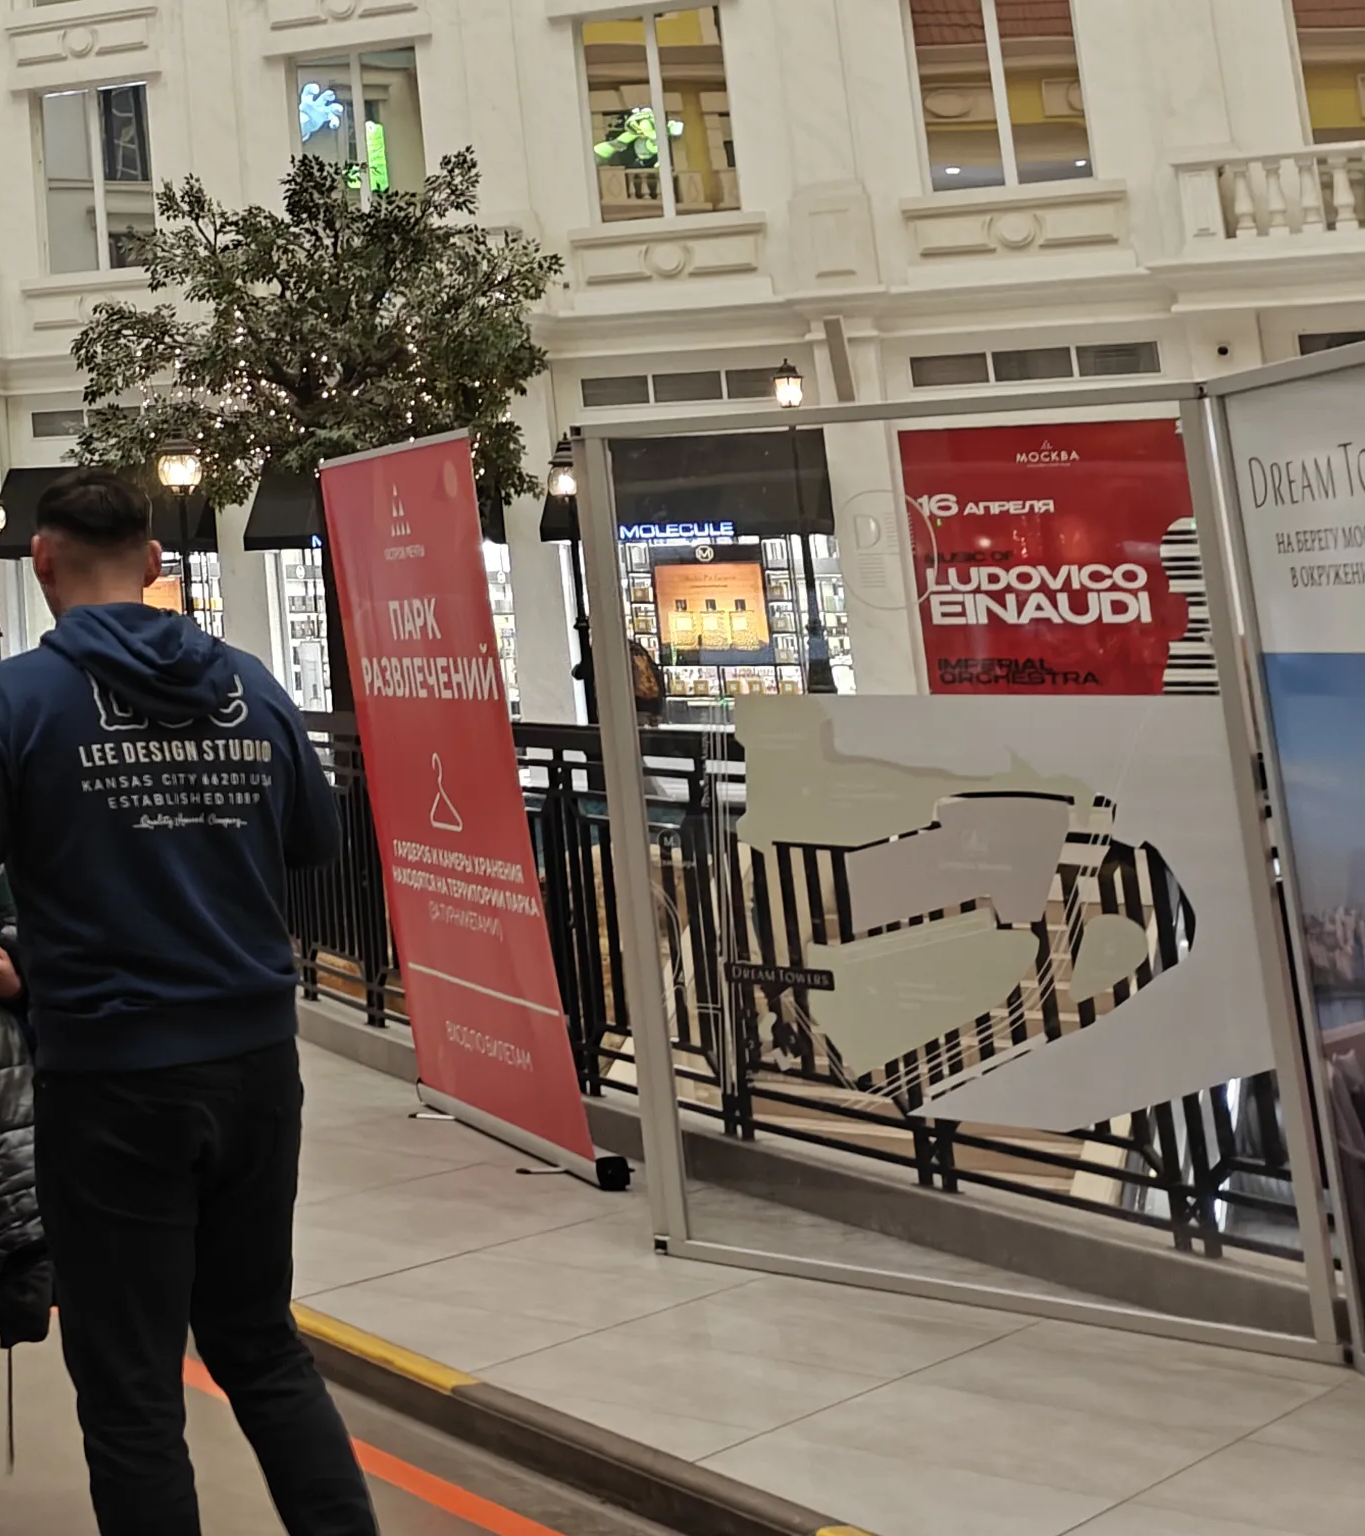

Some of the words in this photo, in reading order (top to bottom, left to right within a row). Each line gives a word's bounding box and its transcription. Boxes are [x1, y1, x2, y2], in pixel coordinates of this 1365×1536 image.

[1016, 450, 1081, 464] МОСКВА
[917, 493, 959, 517] 16
[963, 499, 1055, 516] АПРЕЛЯ
[620, 522, 735, 539] MOLECULE
[1275, 532, 1295, 555] НА
[1295, 526, 1339, 553] БЕРЕГУ
[991, 550, 1014, 562] OF
[926, 563, 1148, 592] LUDOVICO
[1290, 567, 1299, 589] В
[388, 597, 441, 641] ПАРК
[929, 590, 1153, 625] EINAUDI
[361, 643, 499, 701] РАЗВЛЕЧЕНИЙ
[938, 658, 1054, 672] IMPERIAL
[939, 671, 1100, 686] ORCHESTRA
[78, 742, 119, 768] LEE
[122, 739, 199, 763] DESIGN
[202, 738, 272, 762] STUDIO
[81, 774, 153, 792] KANSAS
[161, 772, 197, 786] CITY
[107, 792, 225, 809] ESTABLISHED
[393, 839, 431, 864] ГАРДЕРОБ
[431, 848, 438, 865] И
[439, 849, 473, 874] КАМЕРЫ
[474, 855, 525, 885] ХРАНЕНИЯ
[392, 865, 436, 893] НАХОДЯТСЯ
[447, 877, 506, 910] ТЕРРИТОРИИ
[505, 890, 541, 917] ПАРКА
